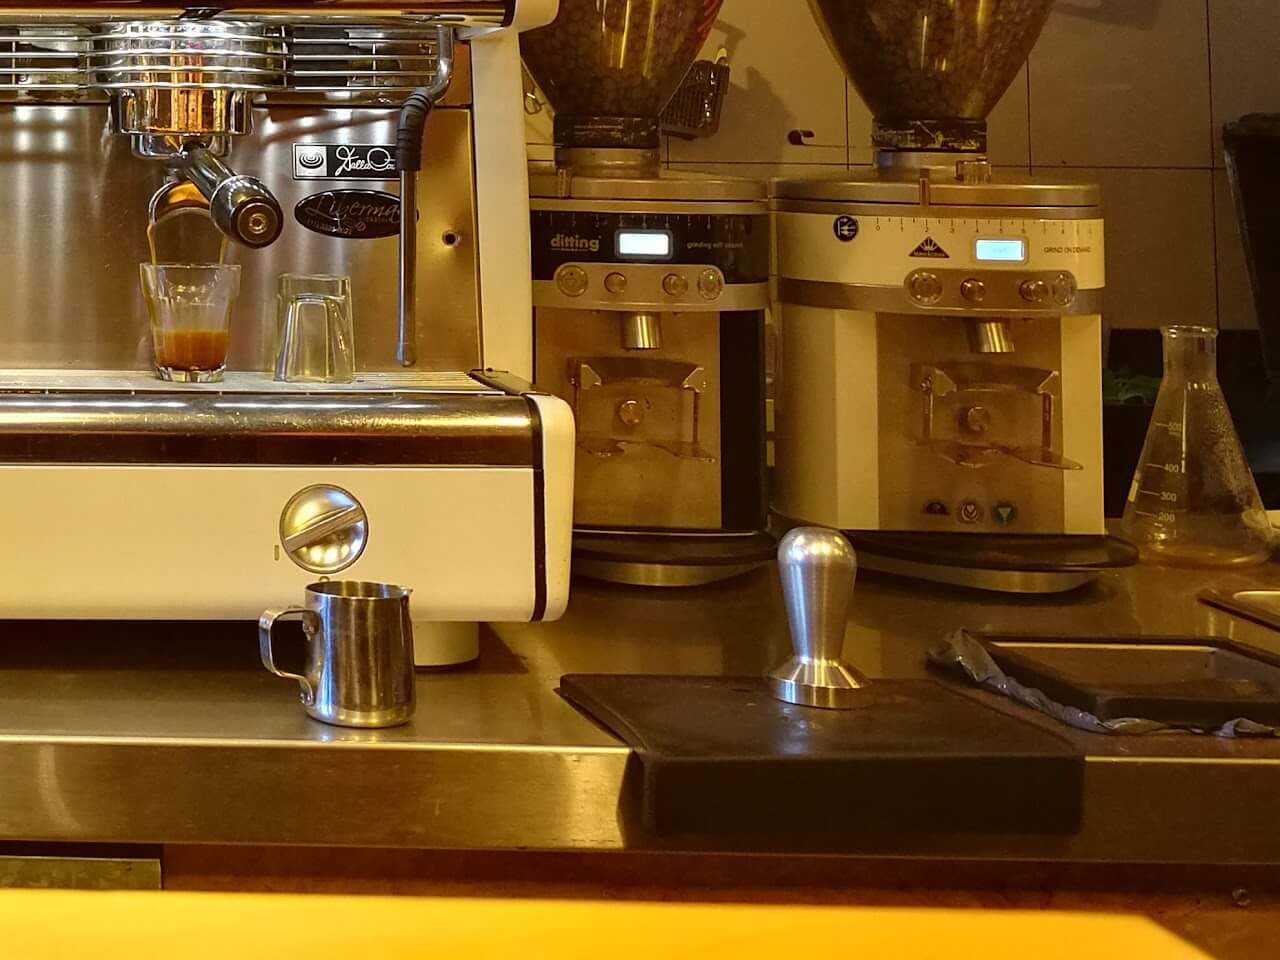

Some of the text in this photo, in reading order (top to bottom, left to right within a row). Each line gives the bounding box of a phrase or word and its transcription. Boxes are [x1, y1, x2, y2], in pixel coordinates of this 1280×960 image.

[551, 234, 599, 252] ditting
[1165, 463, 1179, 473] 400
[1161, 491, 1176, 501] 300
